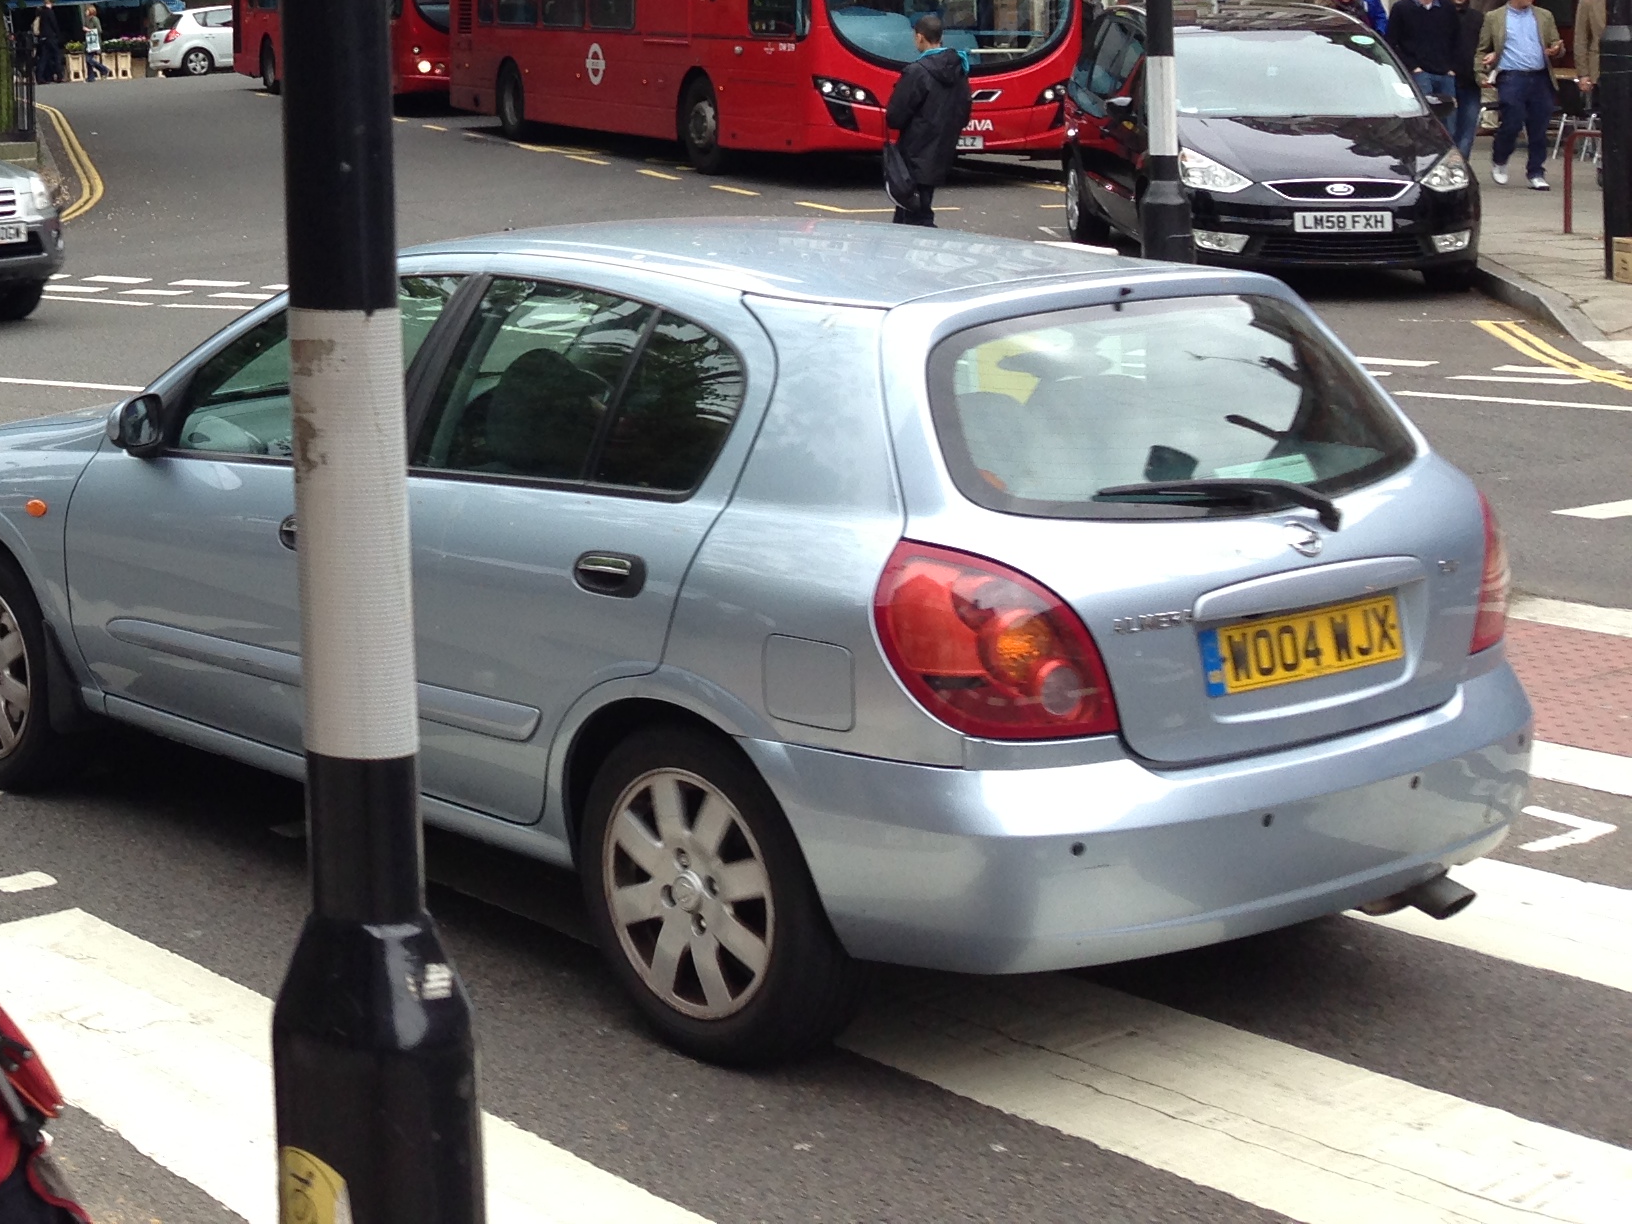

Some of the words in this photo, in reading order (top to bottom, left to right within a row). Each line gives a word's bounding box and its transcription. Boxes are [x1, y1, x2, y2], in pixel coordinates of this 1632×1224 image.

[1302, 215, 1347, 229] LM58
[1351, 214, 1385, 229] FXH
[1226, 621, 1323, 682] WO04
[1329, 604, 1397, 662] WJX
